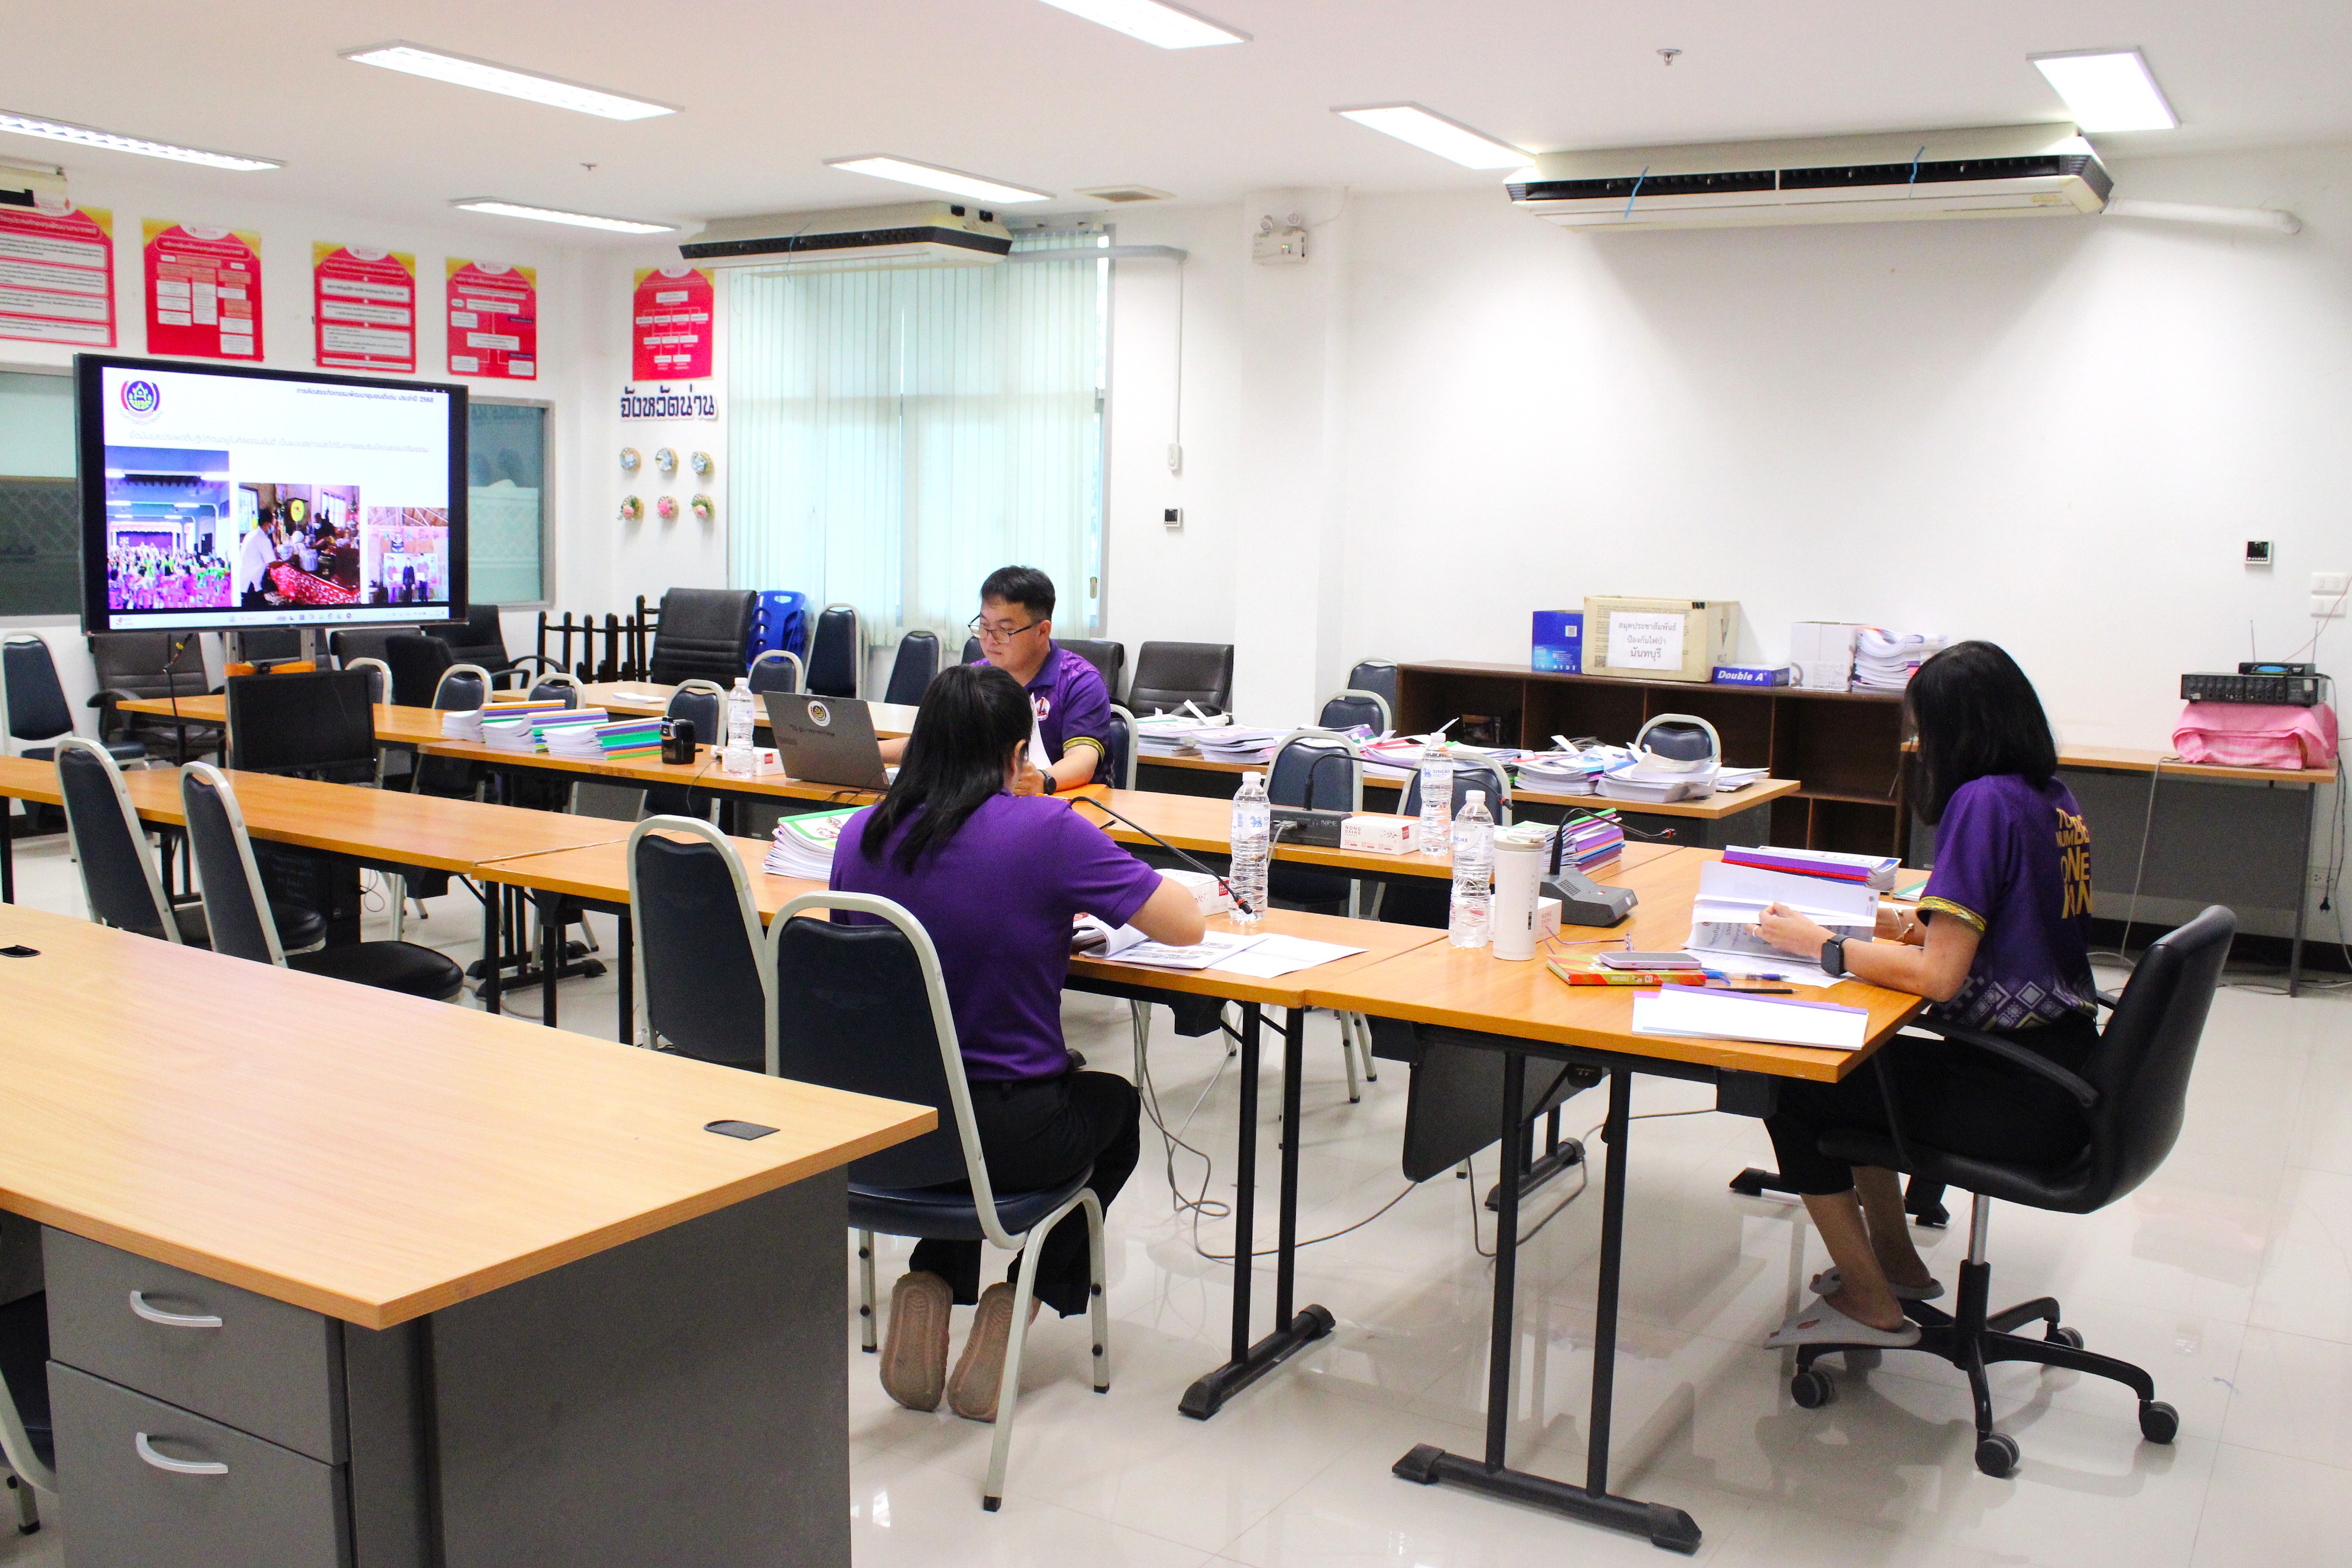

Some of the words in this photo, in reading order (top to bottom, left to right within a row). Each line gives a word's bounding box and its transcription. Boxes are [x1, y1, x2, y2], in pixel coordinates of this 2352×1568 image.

[621, 384, 714, 417] จังหวัดน่าน
[1619, 622, 1677, 631] สมุดประชาสัมพันธ์
[1628, 635, 1666, 644] ป้องกันไฟป่า
[1630, 646, 1661, 661] นันทบุรี
[1717, 670, 1753, 681] Double
[1755, 672, 1763, 681] A
[2061, 846, 2090, 883] ONE
